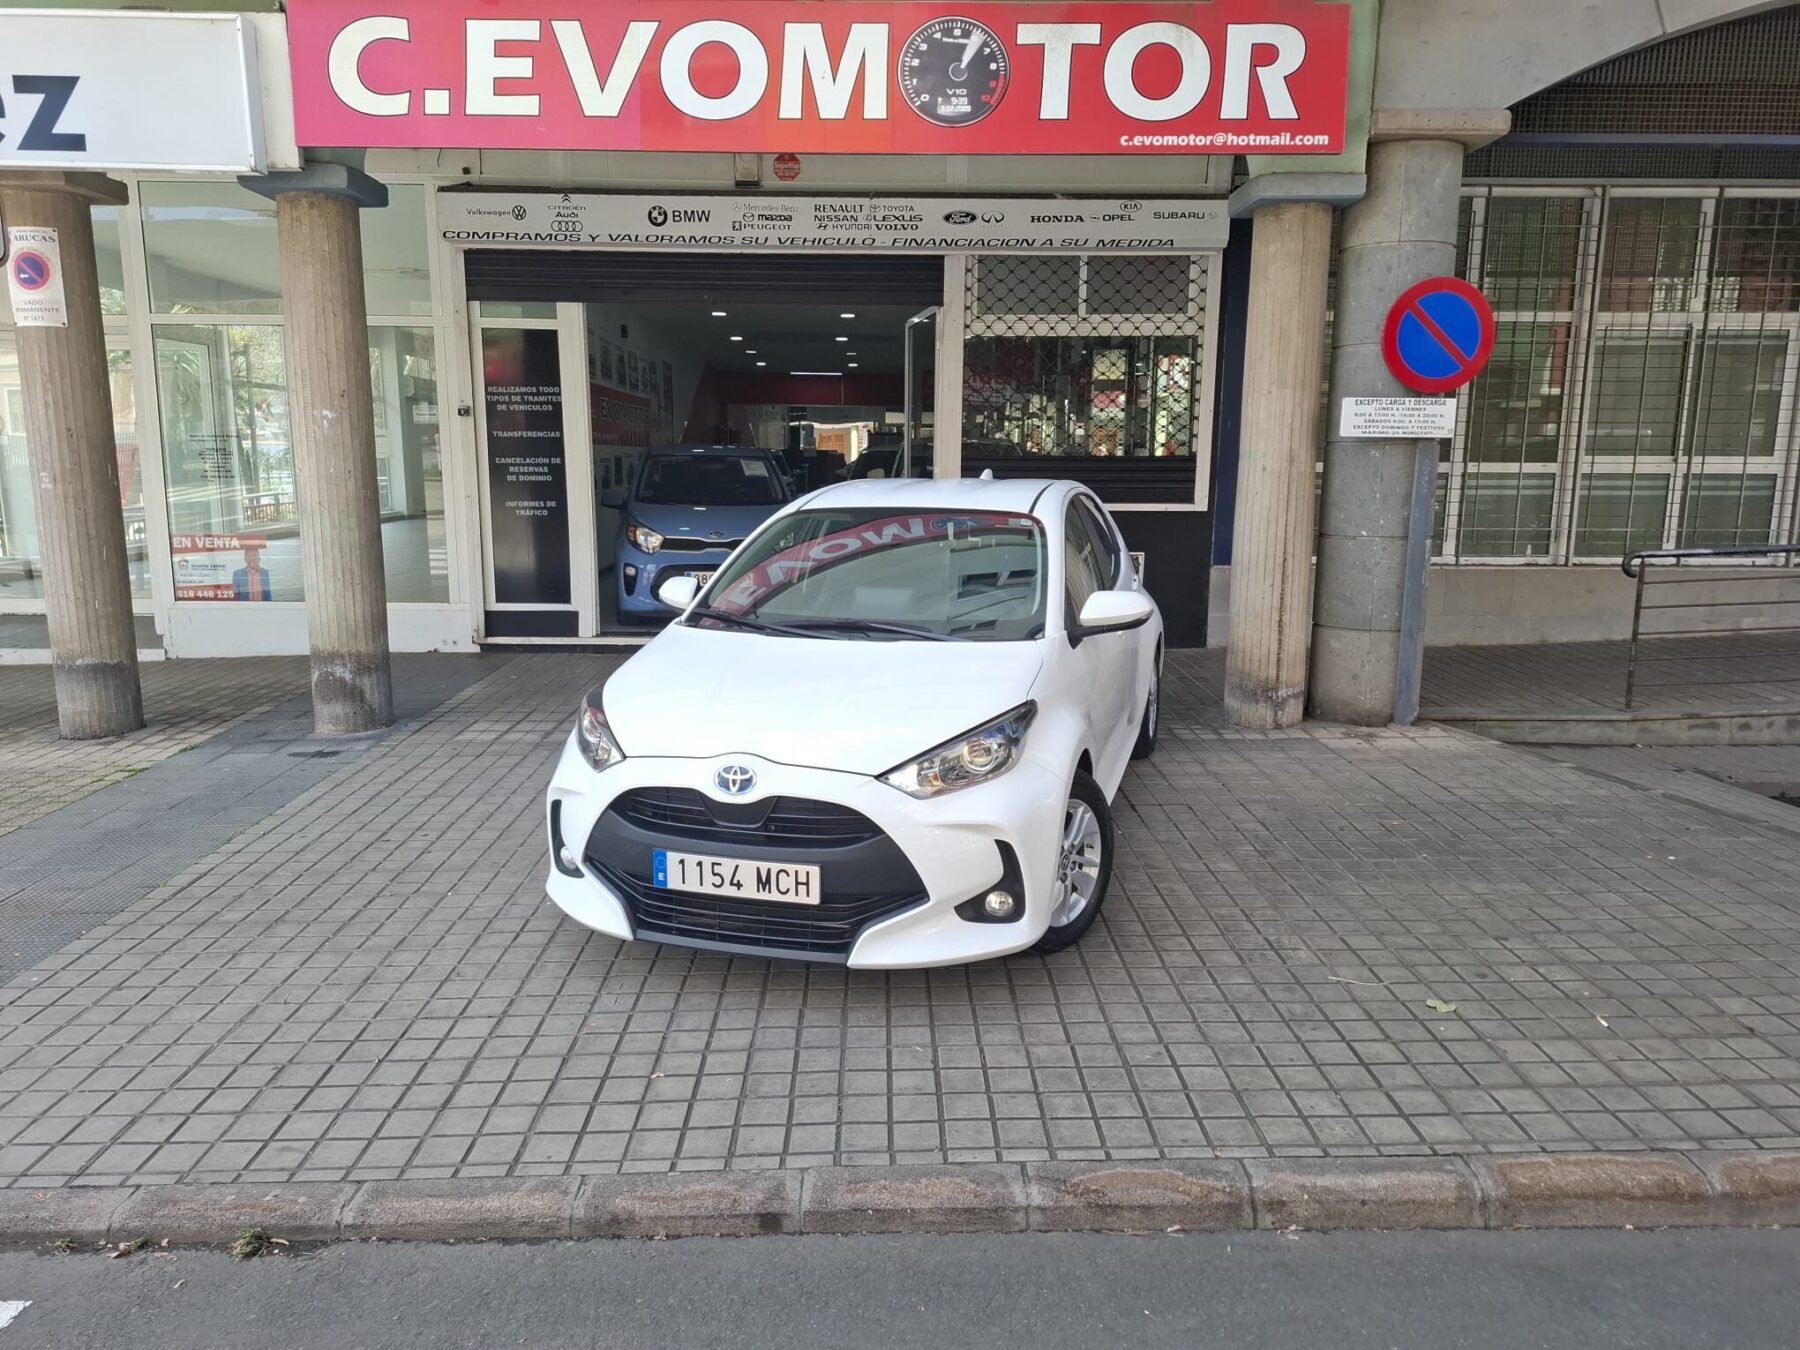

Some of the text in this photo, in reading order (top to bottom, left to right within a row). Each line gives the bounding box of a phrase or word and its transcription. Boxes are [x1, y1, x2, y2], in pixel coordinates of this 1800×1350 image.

[1120, 132, 1328, 146] c.evomotor@hotmail.com
[466, 208, 511, 217] Volkswagen
[743, 203, 800, 212] Mercedes-Benz
[814, 204, 864, 213] RENAULT
[672, 210, 711, 222] BMW
[14, 234, 56, 242] ARUCAS
[442, 230, 581, 242] COMPRAMOS
[588, 234, 600, 242] Y
[608, 234, 735, 244] VALORAMOS
[741, 236, 769, 245] SU
[777, 237, 876, 246] VEHICULO
[891, 238, 1037, 247] FINANCIACION
[1040, 238, 1054, 246] A
[1060, 238, 1089, 247] SU
[1096, 239, 1175, 248] MEDIDA
[172, 537, 240, 548] EN VENTA
[658, 858, 810, 898] E 1154 MCH
